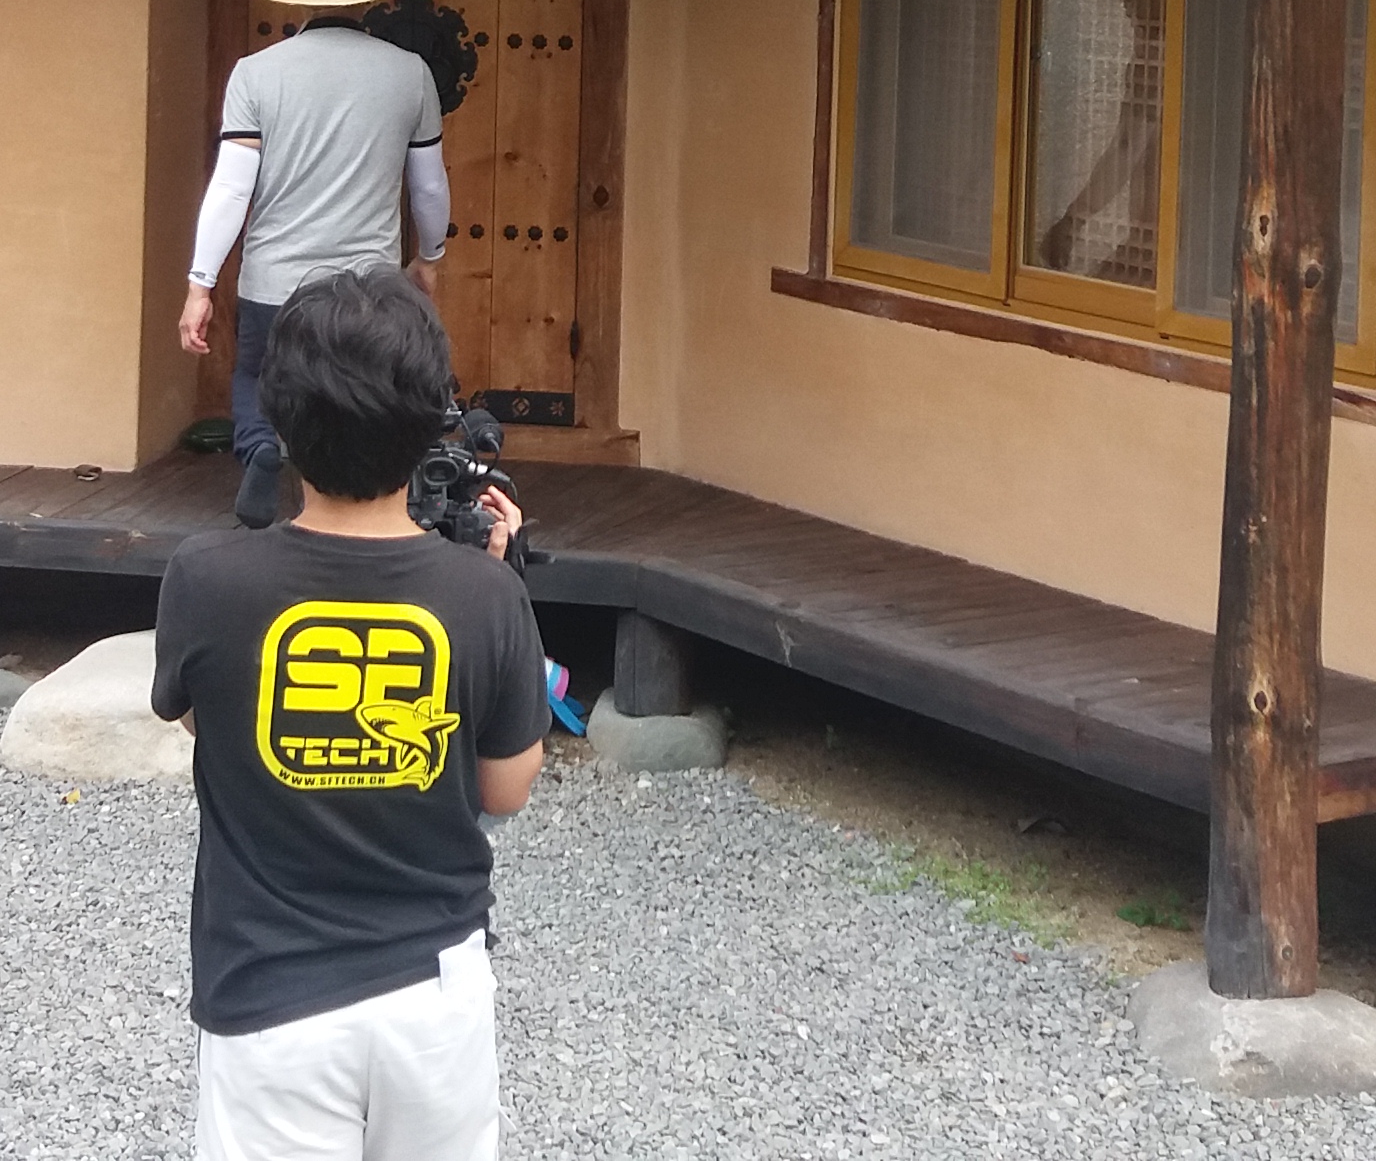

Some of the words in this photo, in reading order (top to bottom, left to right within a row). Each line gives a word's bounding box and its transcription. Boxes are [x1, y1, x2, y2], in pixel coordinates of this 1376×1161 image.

[283, 626, 425, 712] SF
[280, 736, 390, 766] TECH
[278, 768, 386, 786] WWW.SFTECH.CH
